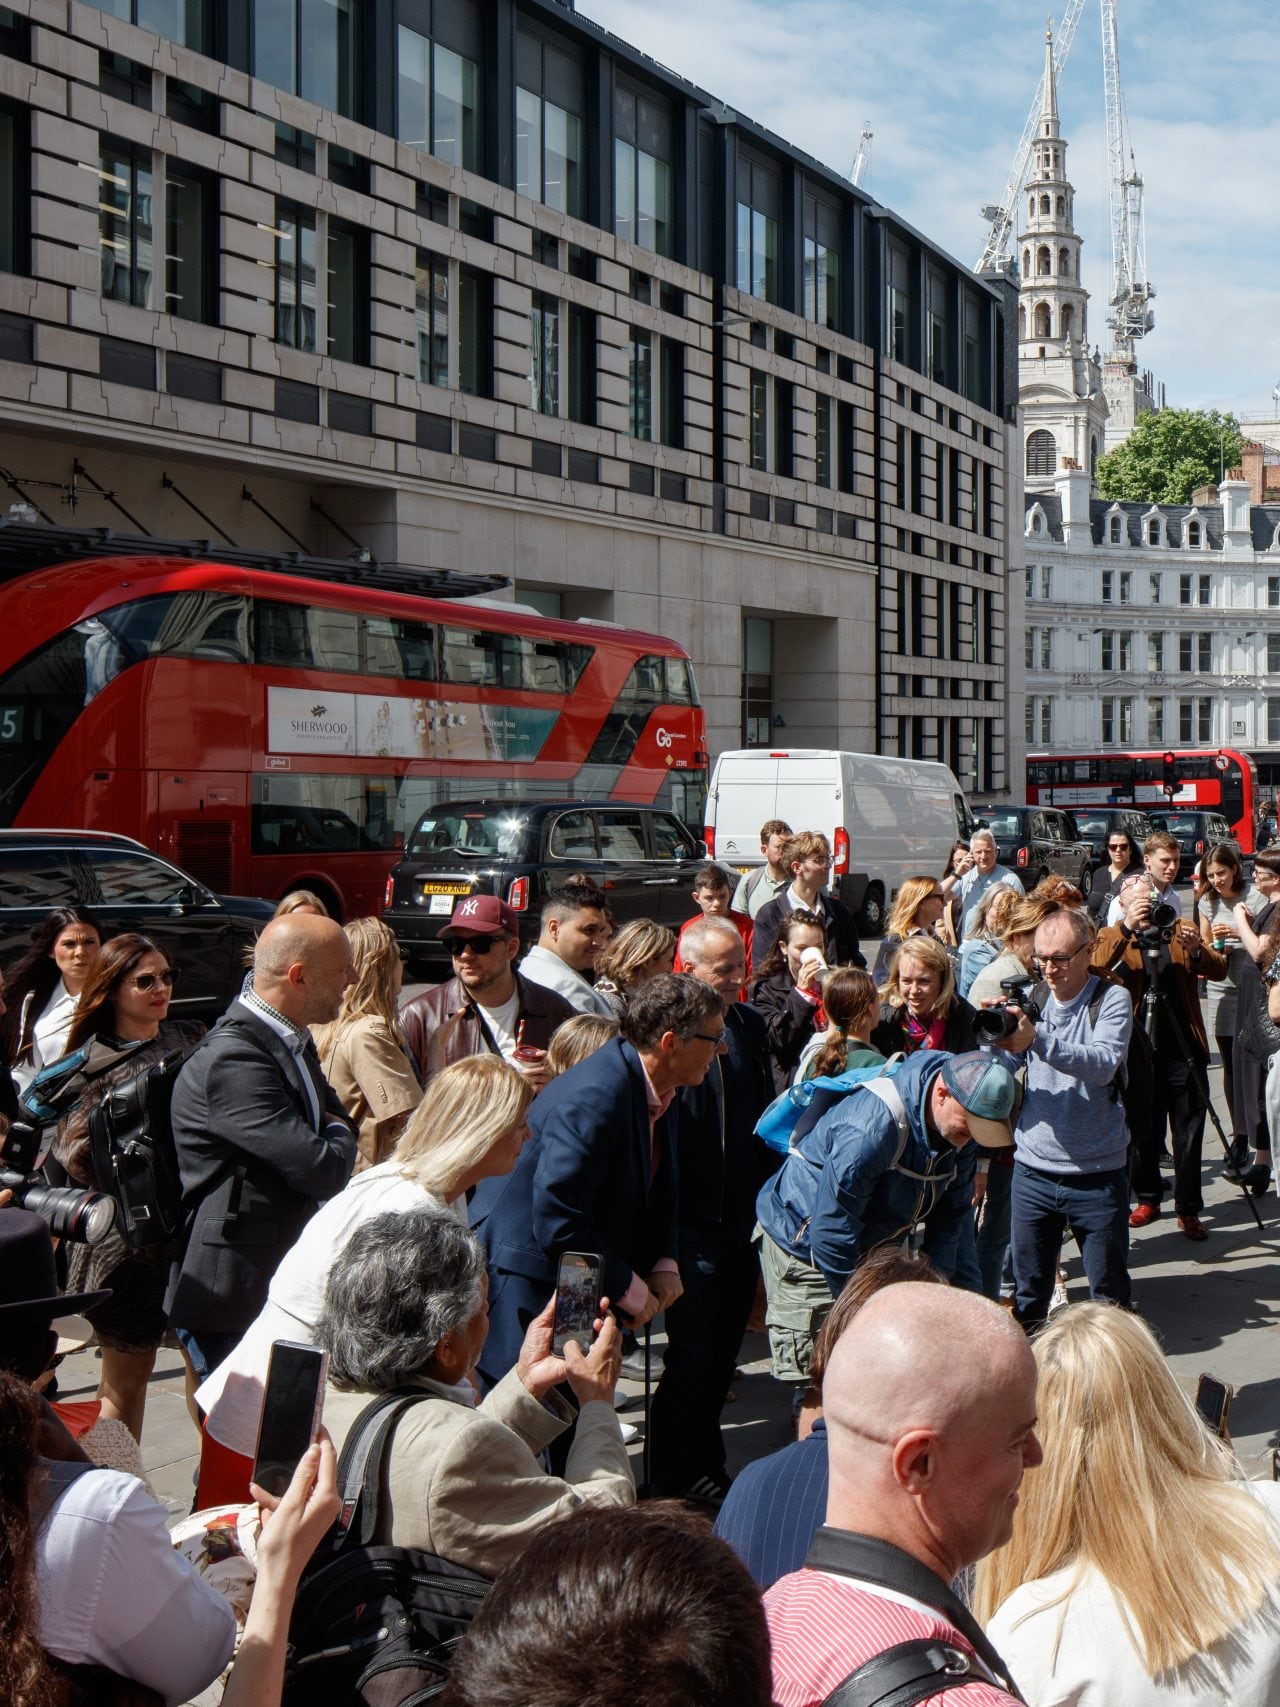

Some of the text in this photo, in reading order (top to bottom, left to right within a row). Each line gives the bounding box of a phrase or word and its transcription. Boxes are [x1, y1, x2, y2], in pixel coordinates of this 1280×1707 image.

[291, 721, 347, 734] SHERWOOD
[656, 727, 672, 748] Go
[460, 900, 479, 916] NY
